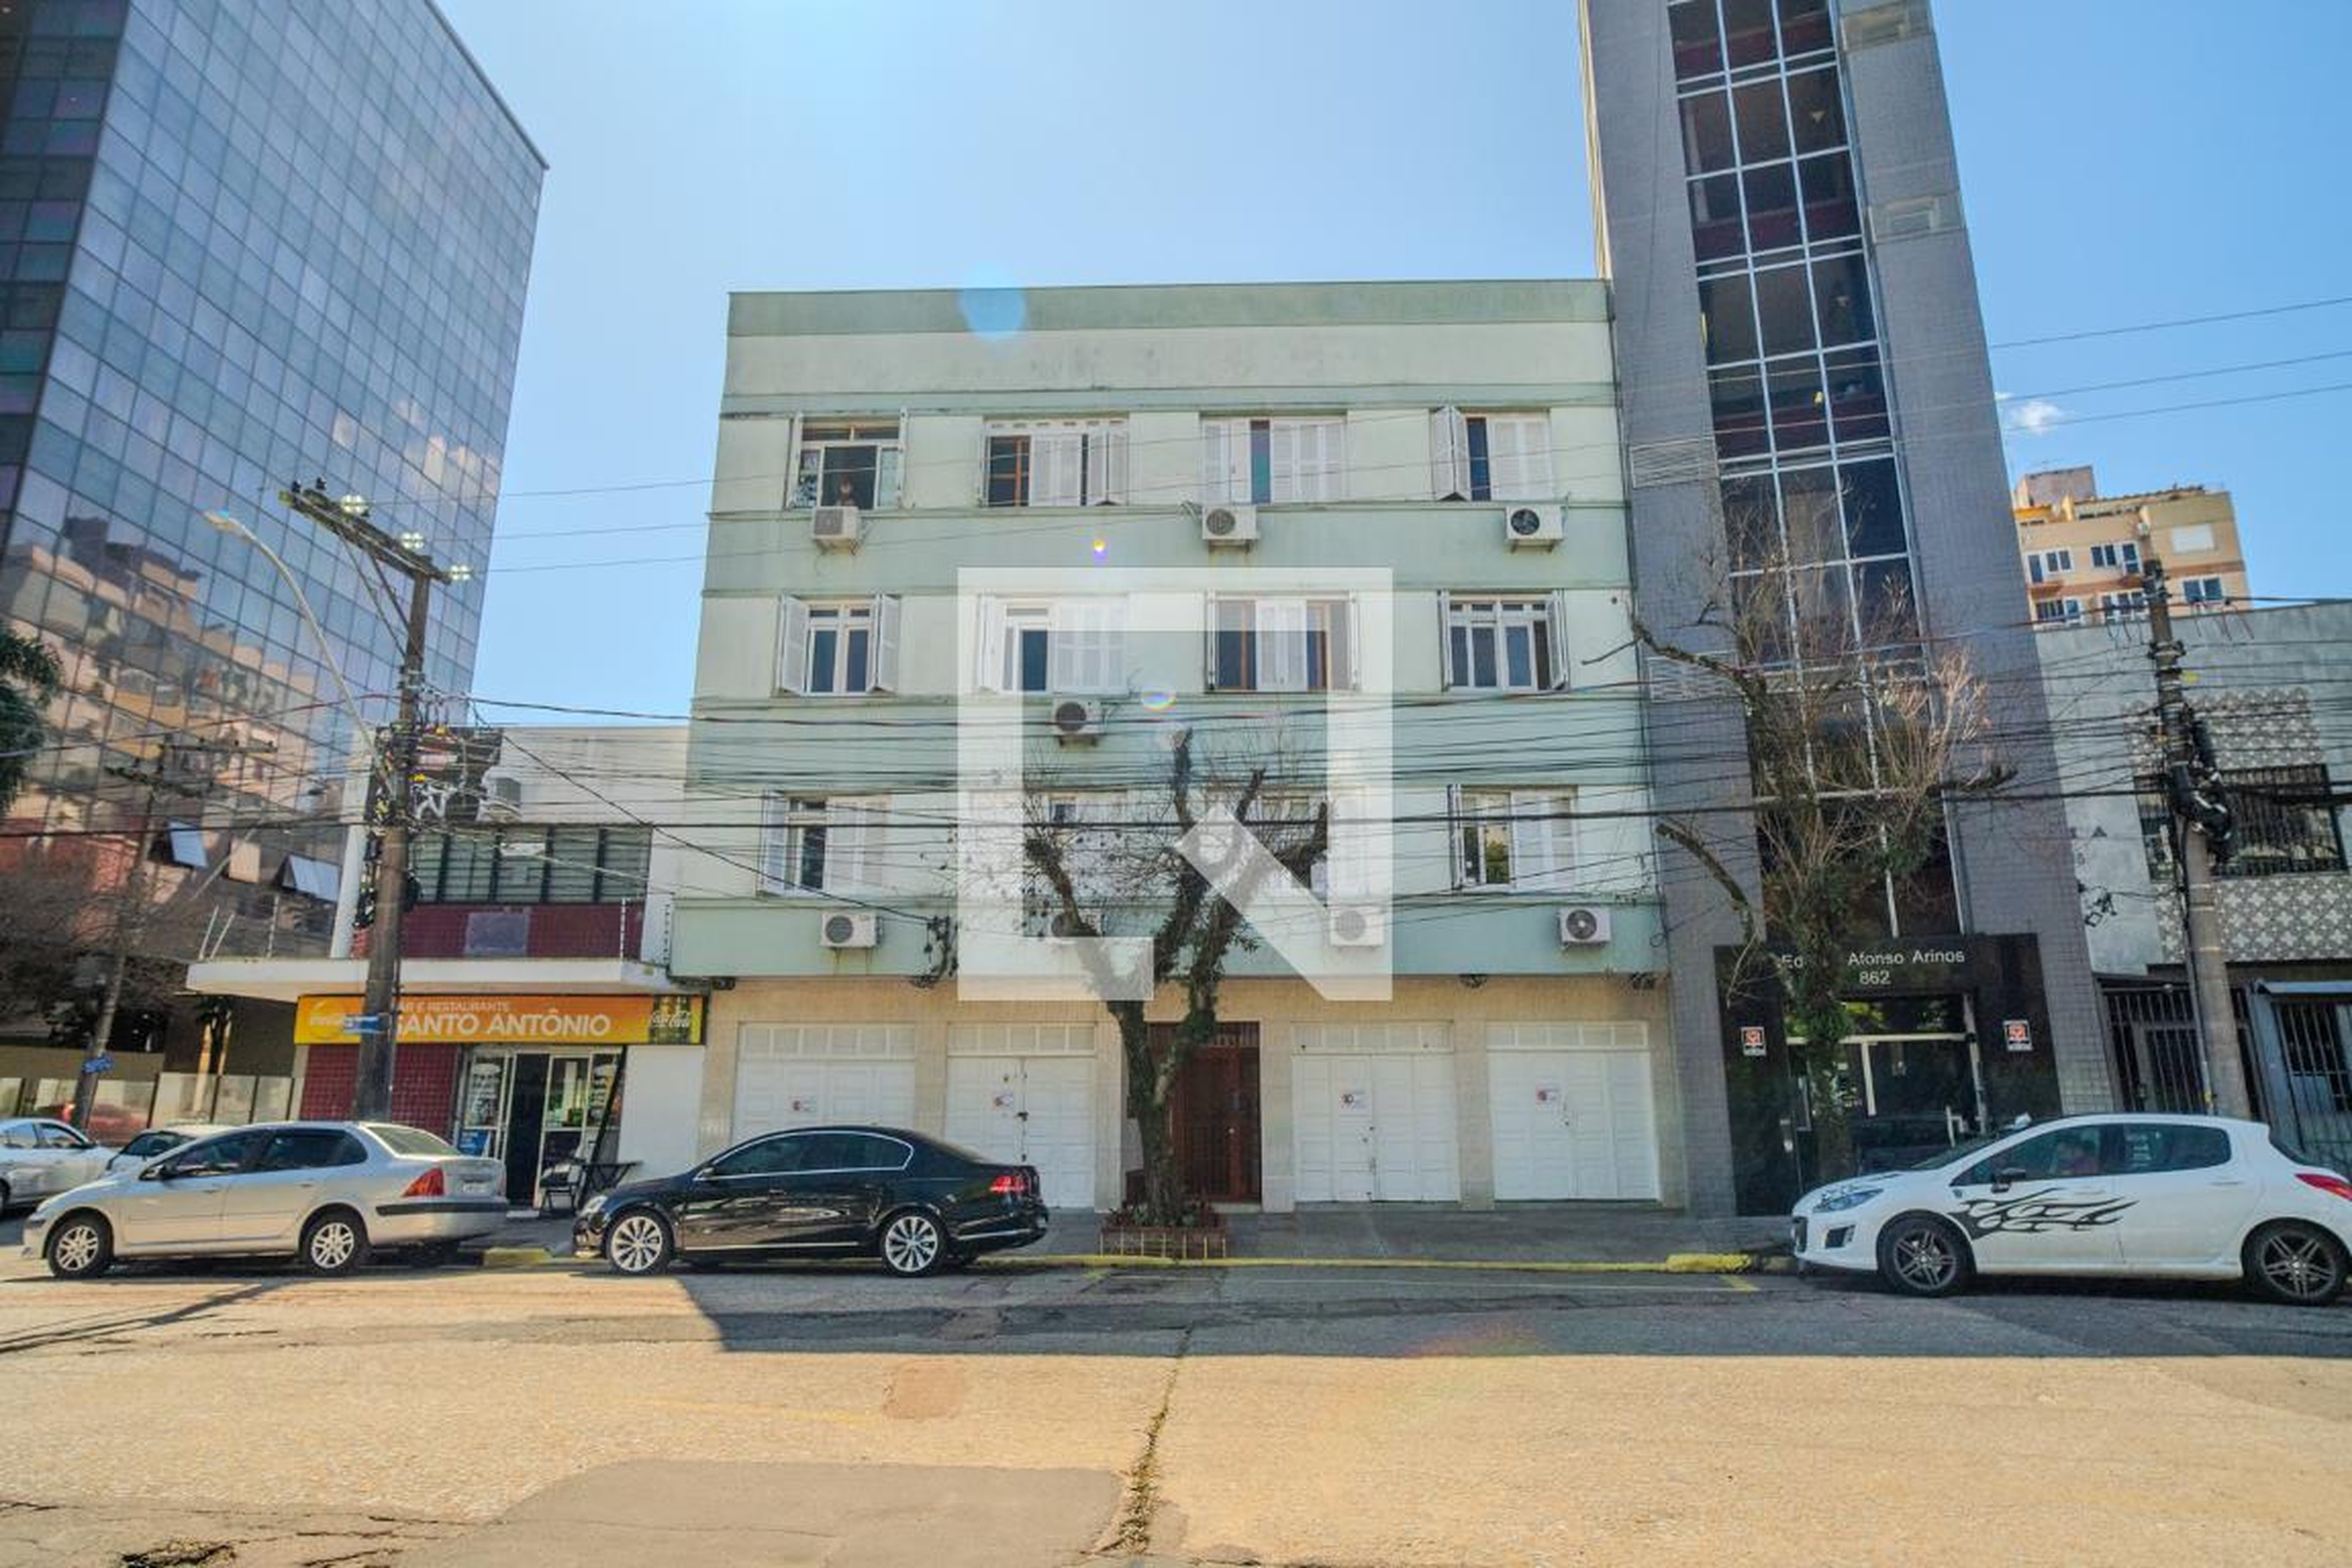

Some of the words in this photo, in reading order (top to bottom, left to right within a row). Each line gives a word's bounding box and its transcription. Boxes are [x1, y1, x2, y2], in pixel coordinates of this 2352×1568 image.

[1847, 952, 1905, 966] Afonso
[1912, 949, 1966, 963] Arinos
[1858, 970, 1891, 986] 862
[487, 1008, 611, 1036] ANTÔNIO
